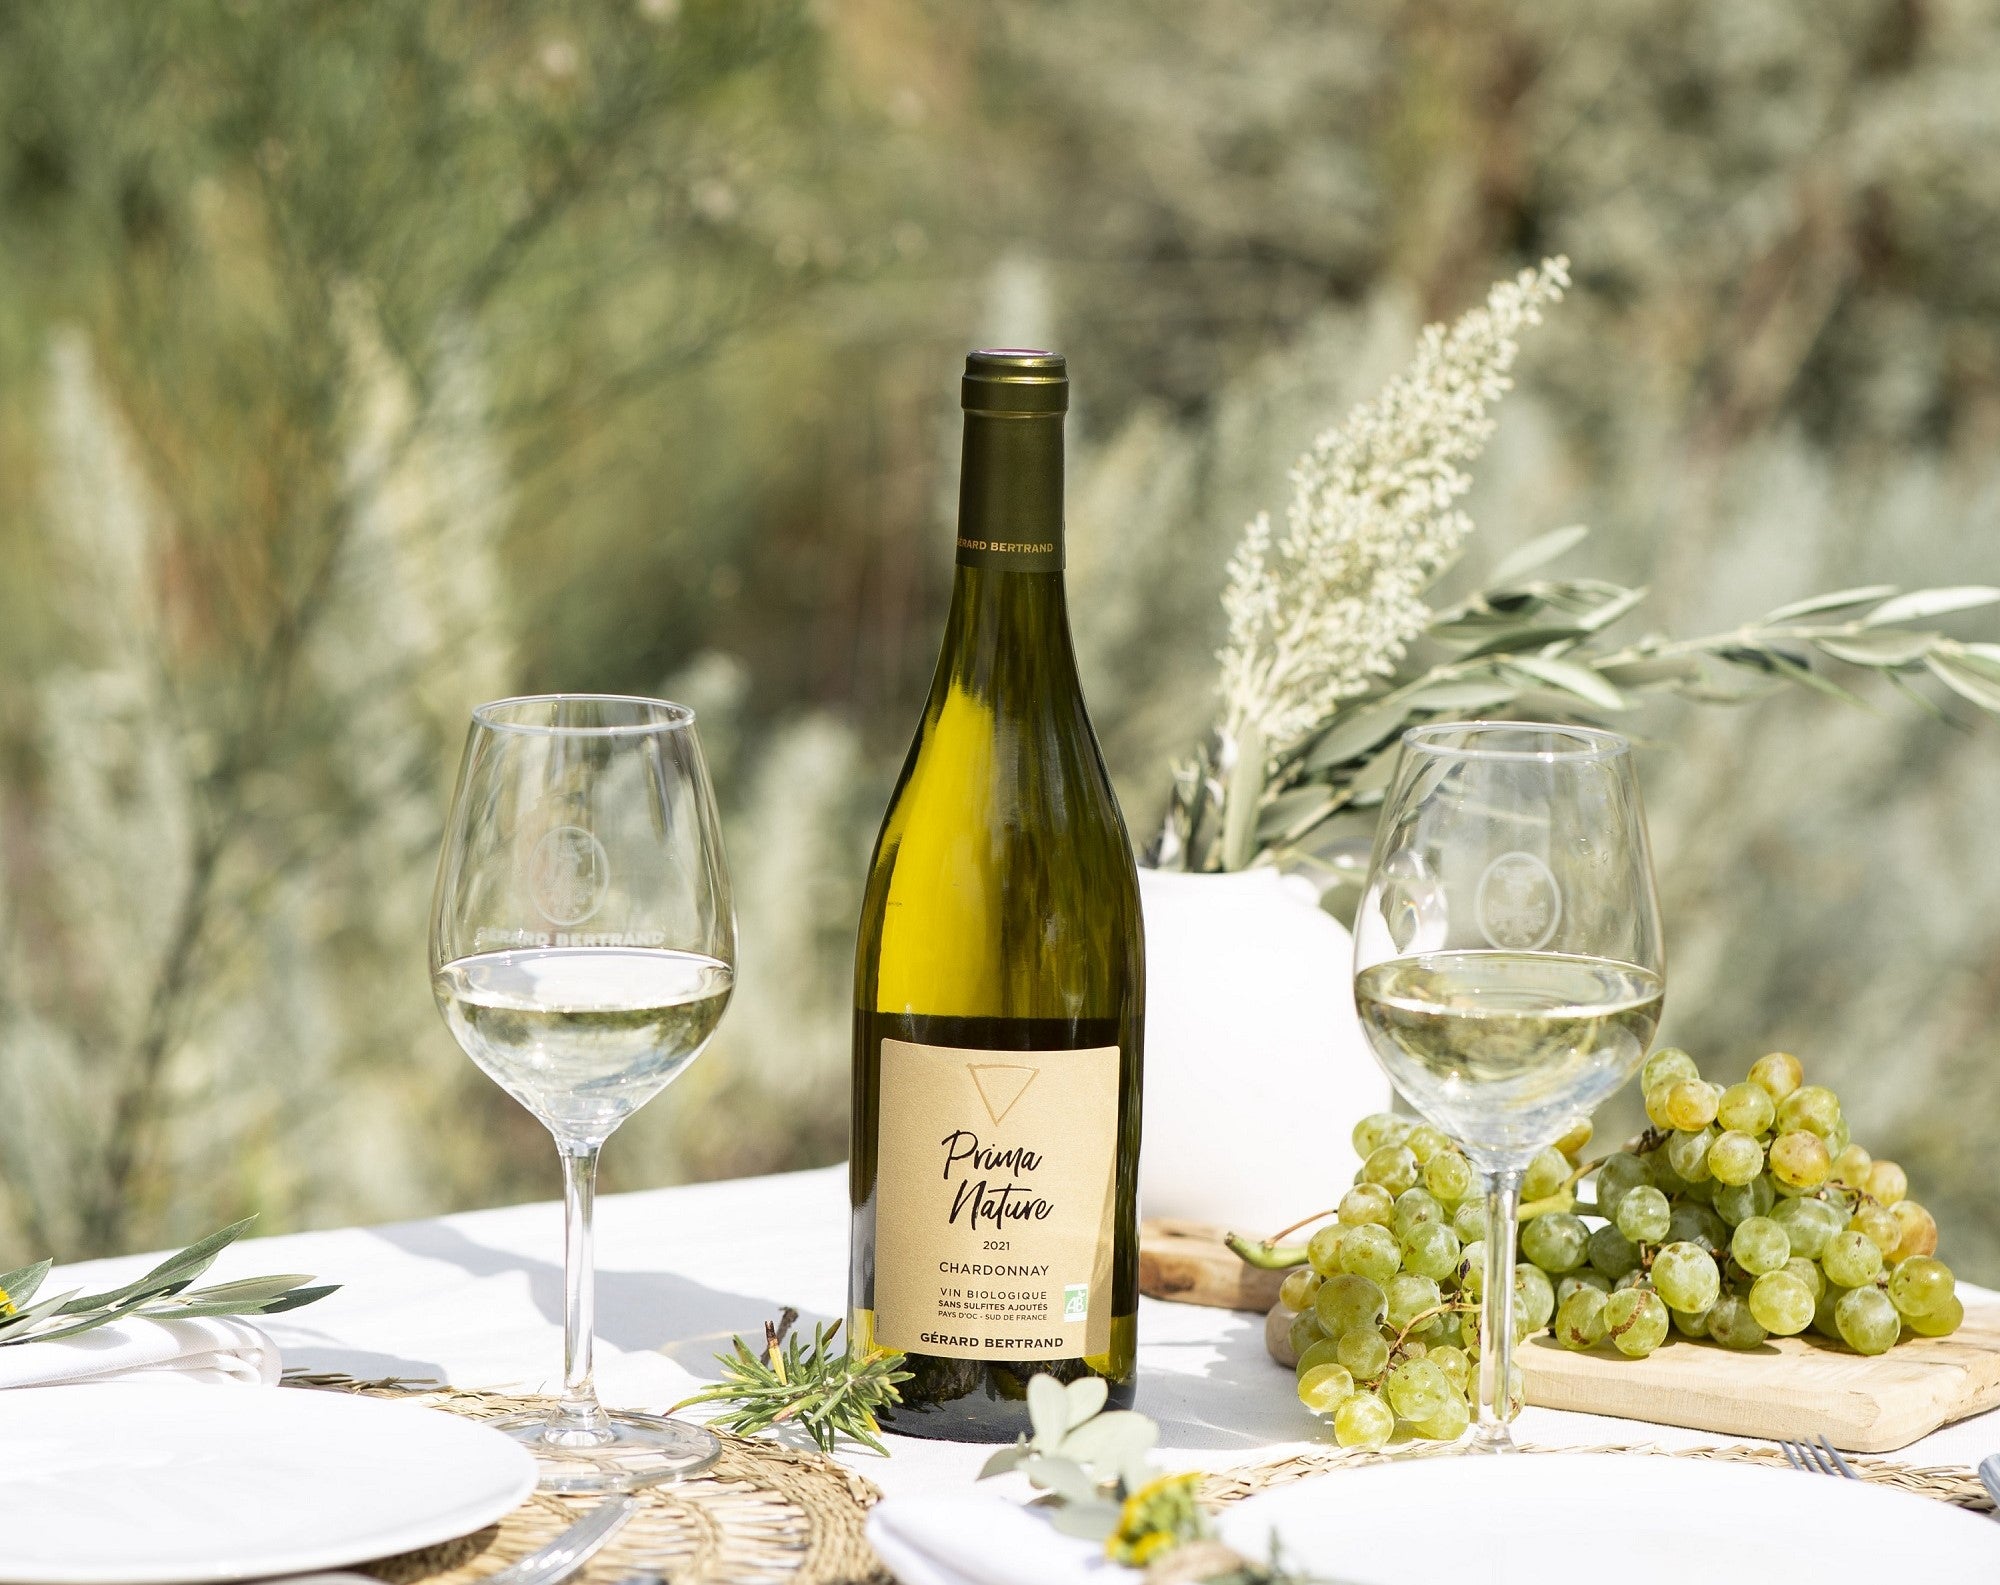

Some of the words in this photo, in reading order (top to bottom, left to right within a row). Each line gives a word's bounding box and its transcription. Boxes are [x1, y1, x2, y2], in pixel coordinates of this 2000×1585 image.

[990, 542, 1054, 553] BERTRAND
[941, 1129, 1043, 1180] Prima
[948, 1179, 1054, 1231] Nature
[983, 1240, 1010, 1251] 2021
[939, 1261, 1049, 1276] CHARDONNAY
[940, 1287, 961, 1298] VIN
[967, 1290, 1047, 1300] BIOLOGIQUE
[938, 1299, 962, 1309] SANS
[963, 1302, 1005, 1311] SULFITES
[1007, 1302, 1048, 1311] AJOUTÉS
[938, 1310, 957, 1319] PAYS
[958, 1312, 978, 1320] D'OC
[985, 1313, 1001, 1321] SUD
[920, 1331, 980, 1348] GÉRARD
[984, 1337, 1064, 1349] BERTRAND
